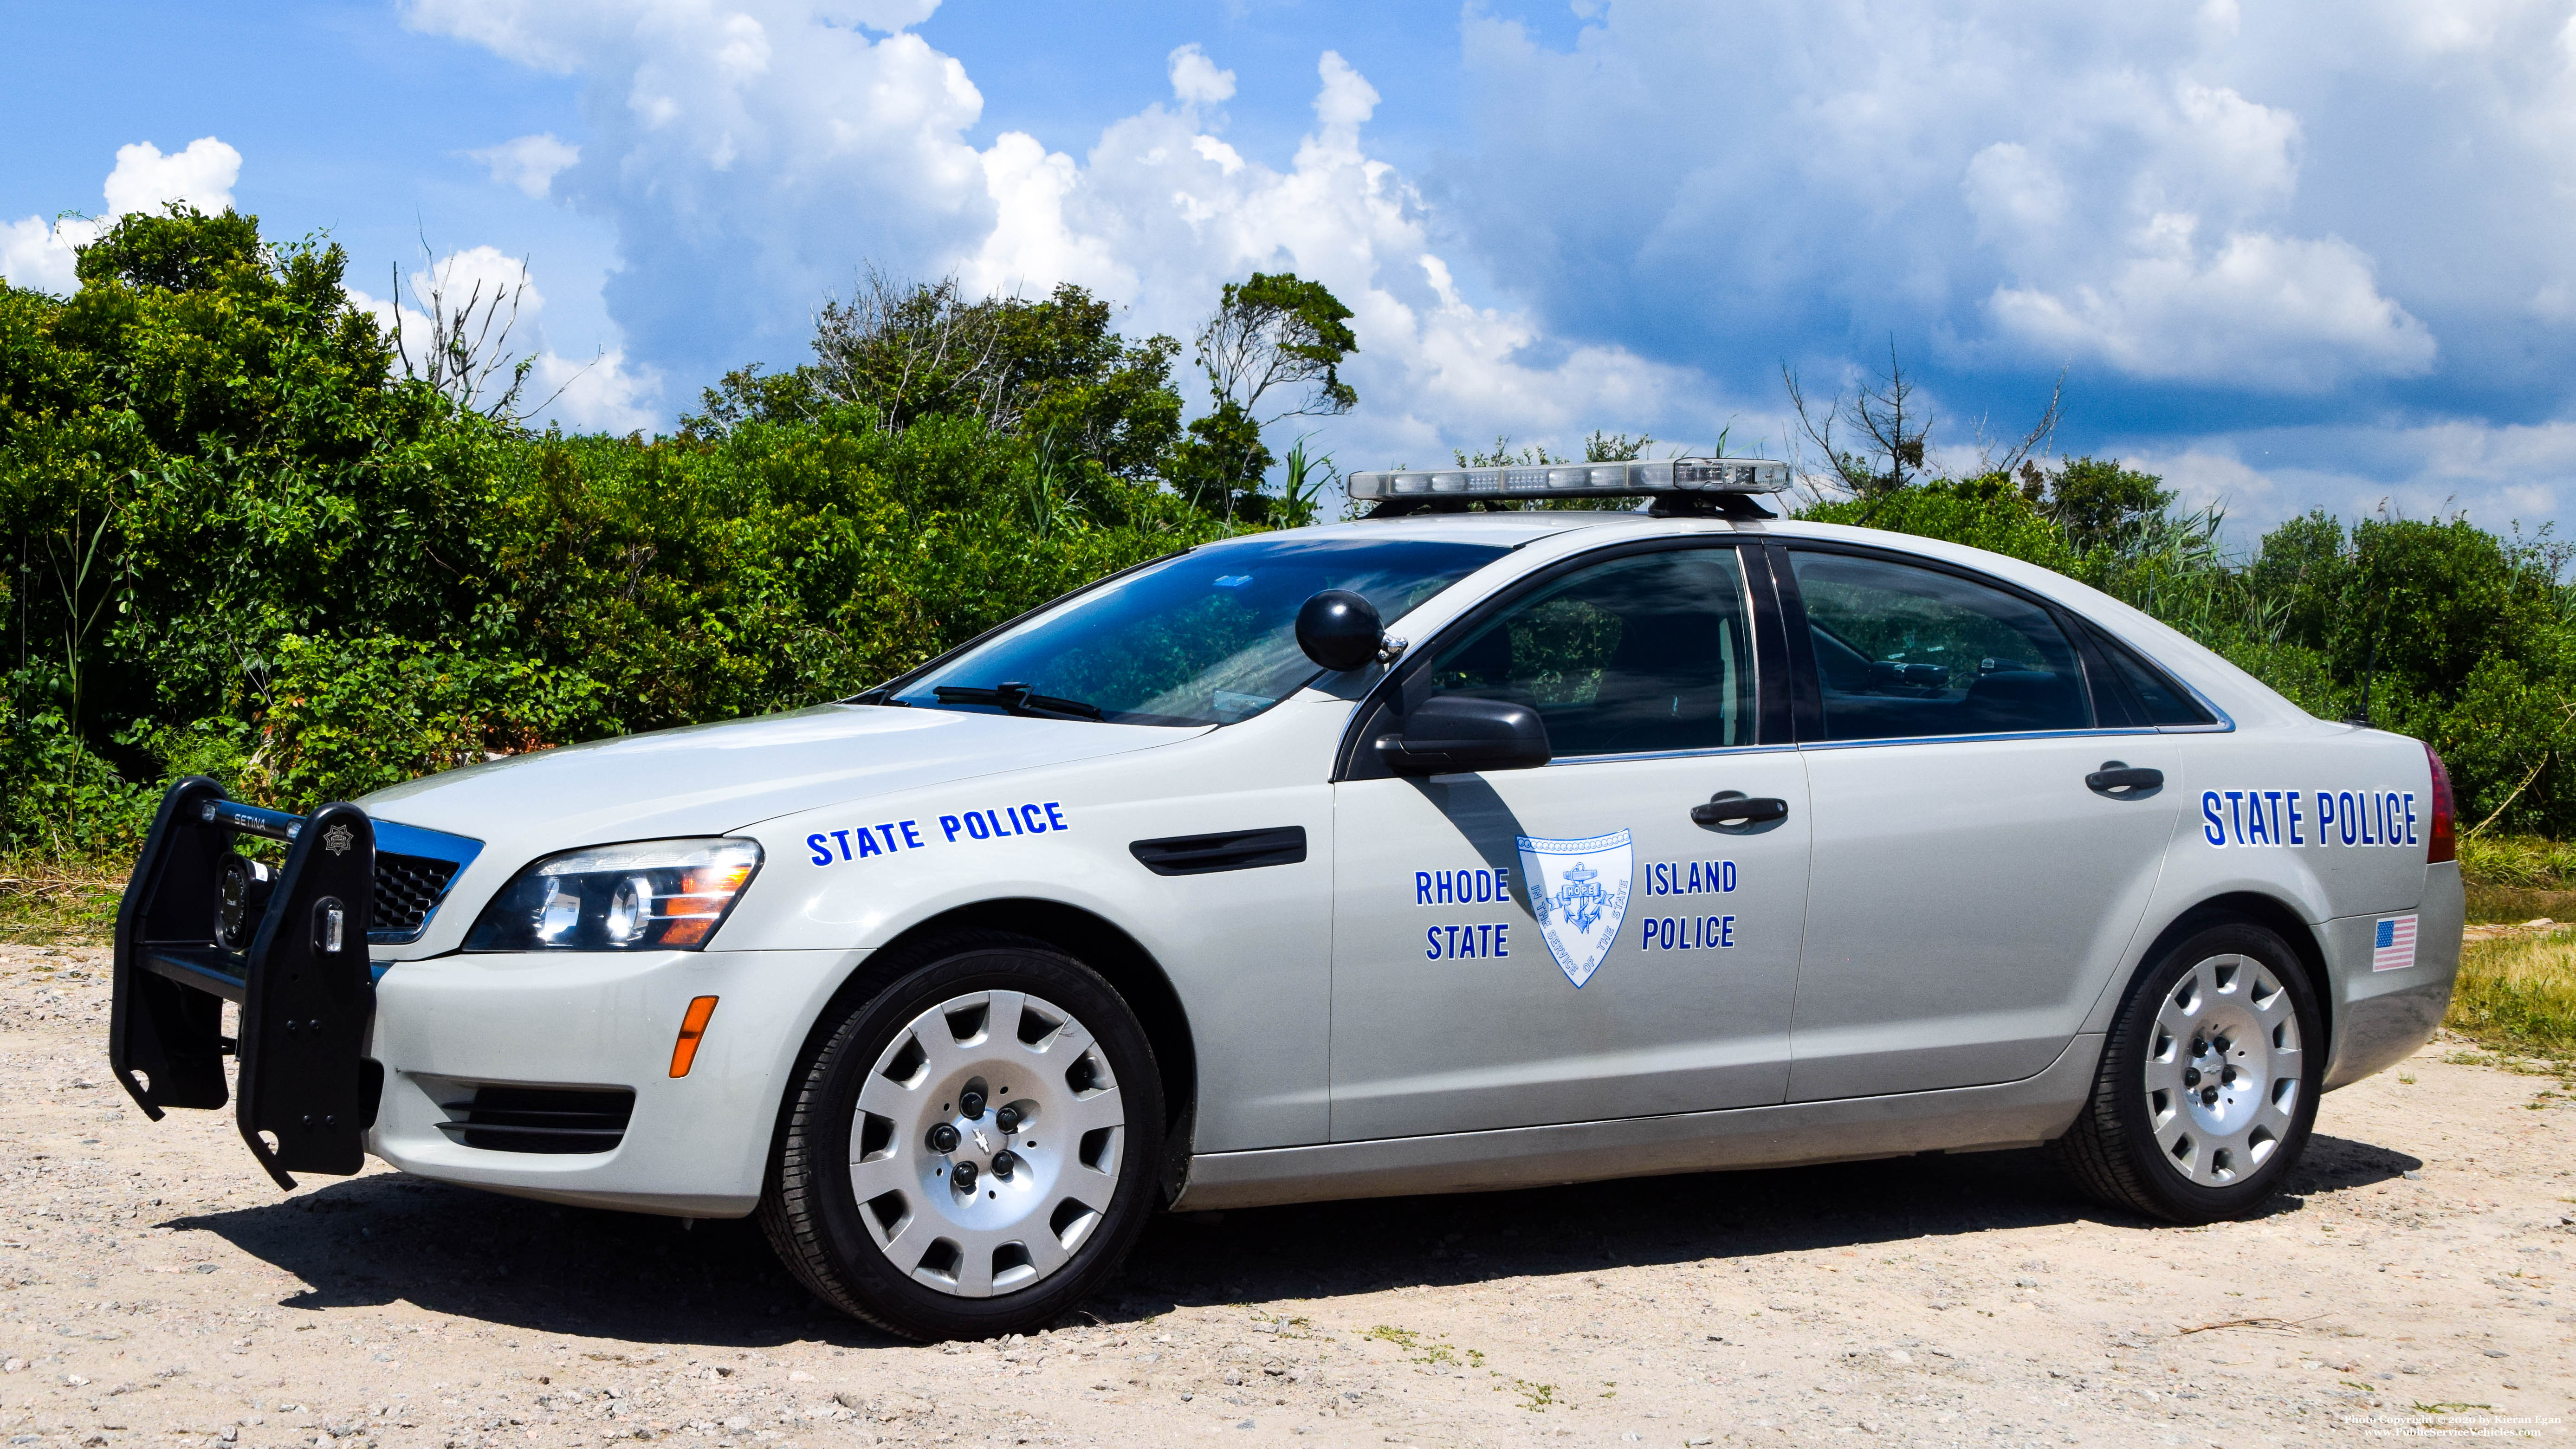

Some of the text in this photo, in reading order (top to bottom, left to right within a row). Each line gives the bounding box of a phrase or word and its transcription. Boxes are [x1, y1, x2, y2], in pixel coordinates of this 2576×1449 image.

[235, 813, 265, 830] SETINA
[806, 801, 1069, 867] STATE POLICE
[2201, 790, 2418, 848] STATE POLICE
[1415, 860, 1738, 906] RHODE ISLAND
[1567, 886, 1594, 896] HOPE
[1425, 915, 1736, 961] STATE POLICE
[1531, 880, 1628, 976] IN THE SERVICE OF THE STATE
